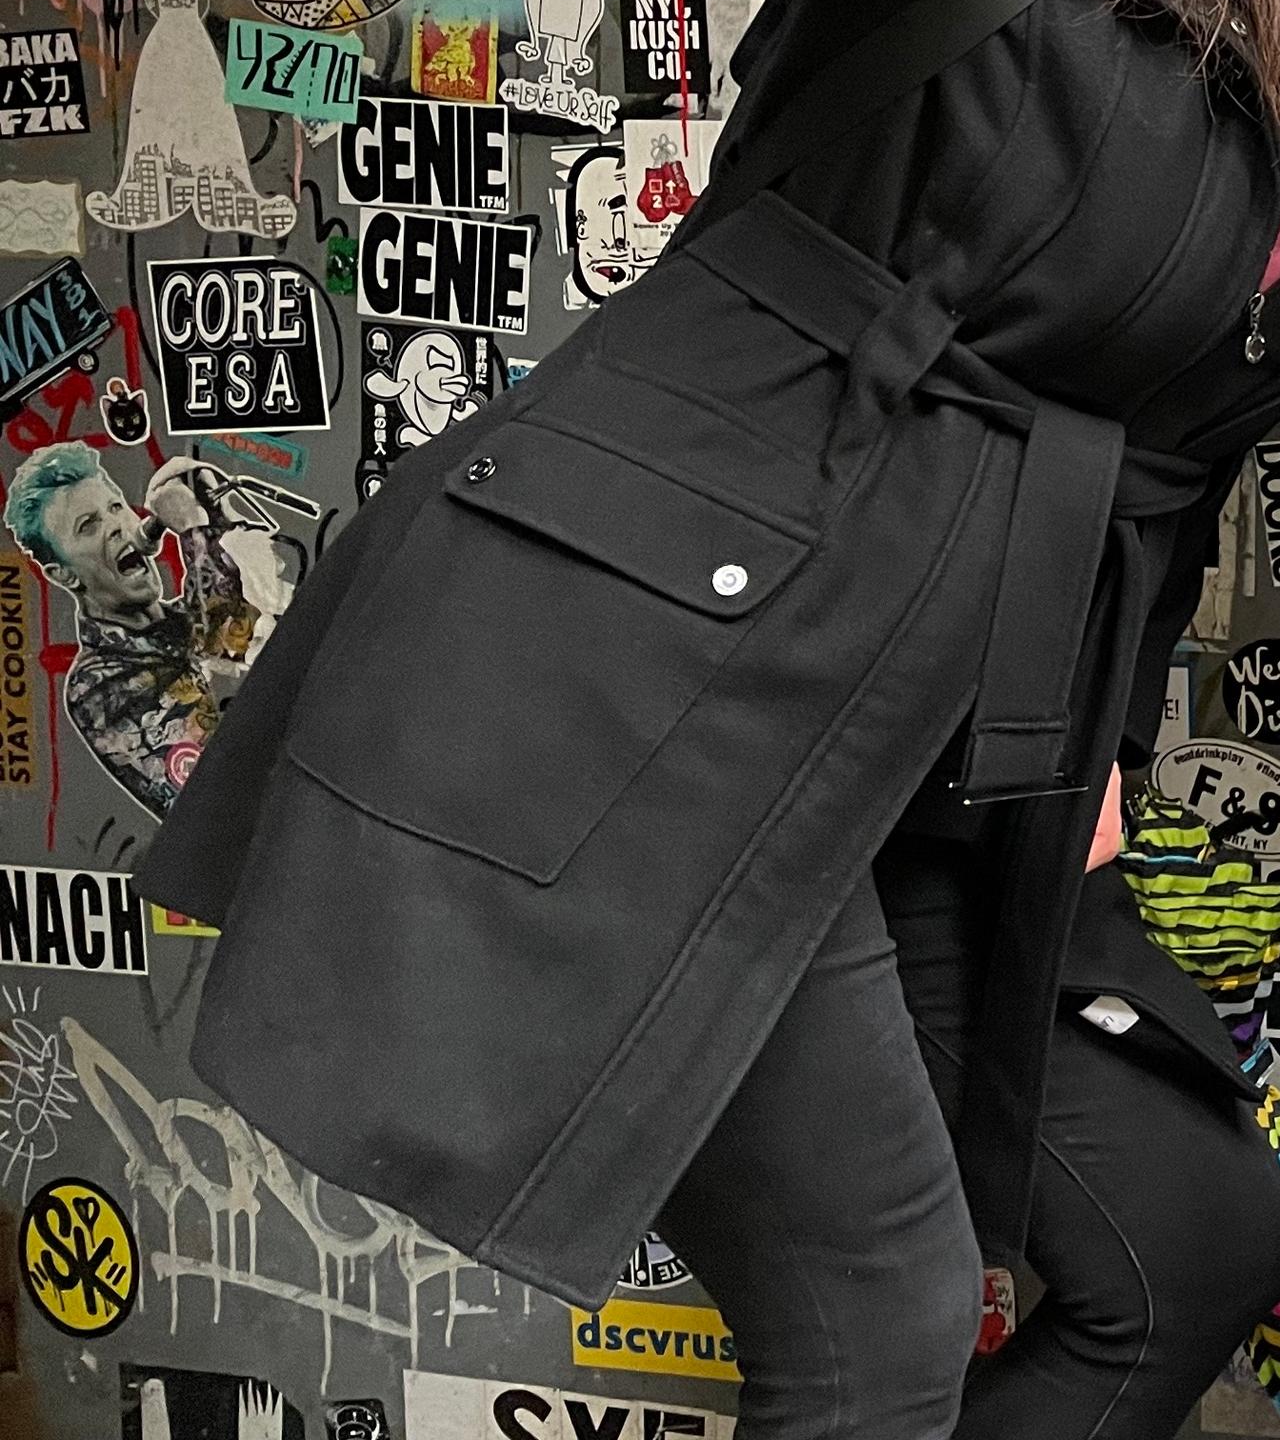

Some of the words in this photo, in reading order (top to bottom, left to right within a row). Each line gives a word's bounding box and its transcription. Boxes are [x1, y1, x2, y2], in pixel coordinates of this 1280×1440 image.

[629, 19, 701, 51] KUSH
[646, 53, 692, 82] CO.
[342, 104, 506, 209] GENIE
[479, 195, 506, 210] TFM
[360, 212, 528, 329] GENIE
[161, 271, 305, 347] CORE
[497, 315, 523, 329] TFM
[187, 352, 296, 414] ESA
[3, 566, 24, 683] COOKIN
[9, 691, 31, 784] STAY
